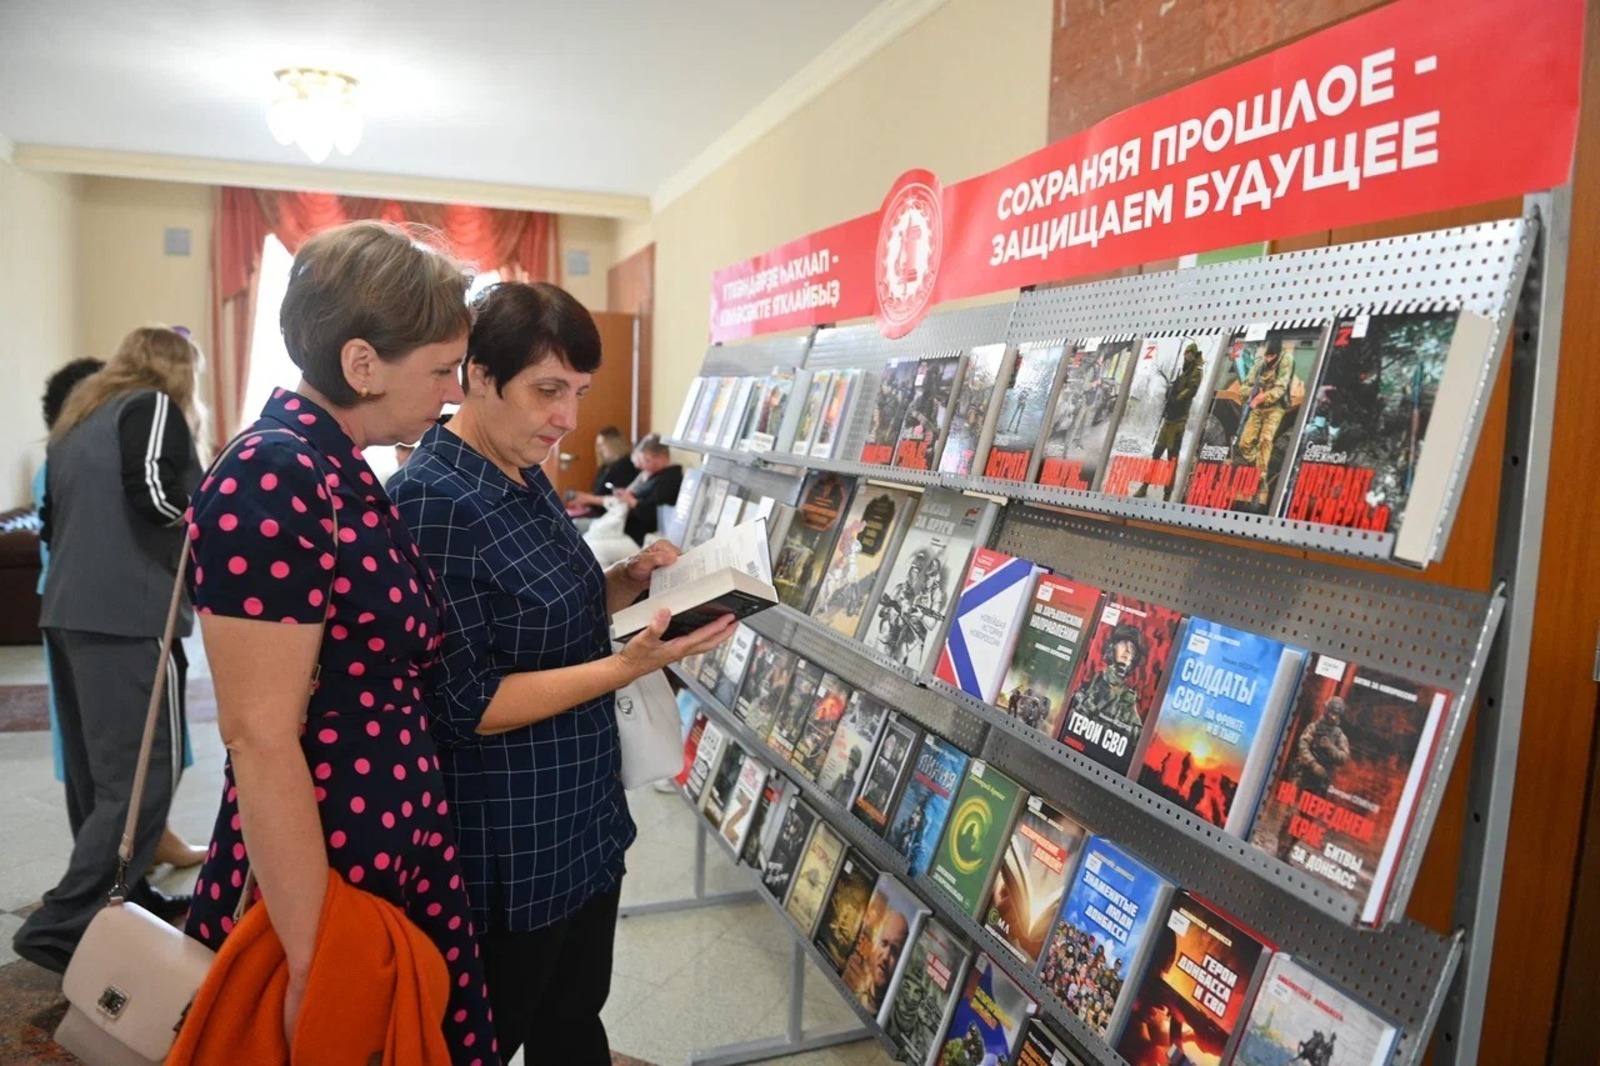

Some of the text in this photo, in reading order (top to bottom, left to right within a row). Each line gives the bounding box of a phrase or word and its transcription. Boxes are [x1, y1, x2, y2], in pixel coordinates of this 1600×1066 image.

[998, 47, 1438, 221] СОХРАНЯЯ ПРОШЛОЕ -
[989, 110, 1441, 267] ЗАЩИЩАЕМ БУДУЩЕЕ
[1143, 346, 1157, 360] Z
[1303, 451, 1347, 464] БЕРЕЖНОЙ
[1295, 461, 1375, 502] КОНТРАКТ
[1311, 495, 1390, 533] СМЕРТЬЮ
[1181, 657, 1259, 707] СОЛДАТЫ
[1171, 686, 1205, 718] СВО
[1067, 711, 1103, 743] ГЕРОИ
[1102, 728, 1129, 757] СВО
[1216, 712, 1246, 732] ФРОНТЕ
[1277, 780, 1377, 844] НА ПЕРЕДНЕМ
[1288, 814, 1327, 849] КРАЕ
[1290, 845, 1358, 890] ЗА ДОНБАСС
[1323, 842, 1364, 871] БИТВЫ
[1083, 871, 1140, 916] ЗНАМЕНИТЫЕ
[1084, 904, 1130, 946] ДОНБАССА
[1105, 904, 1136, 931] ЛЮДИ
[1177, 954, 1232, 1003] ДОНБАССА
[1202, 953, 1239, 989] ГЕРОИ
[1193, 985, 1227, 1018] И СВО
